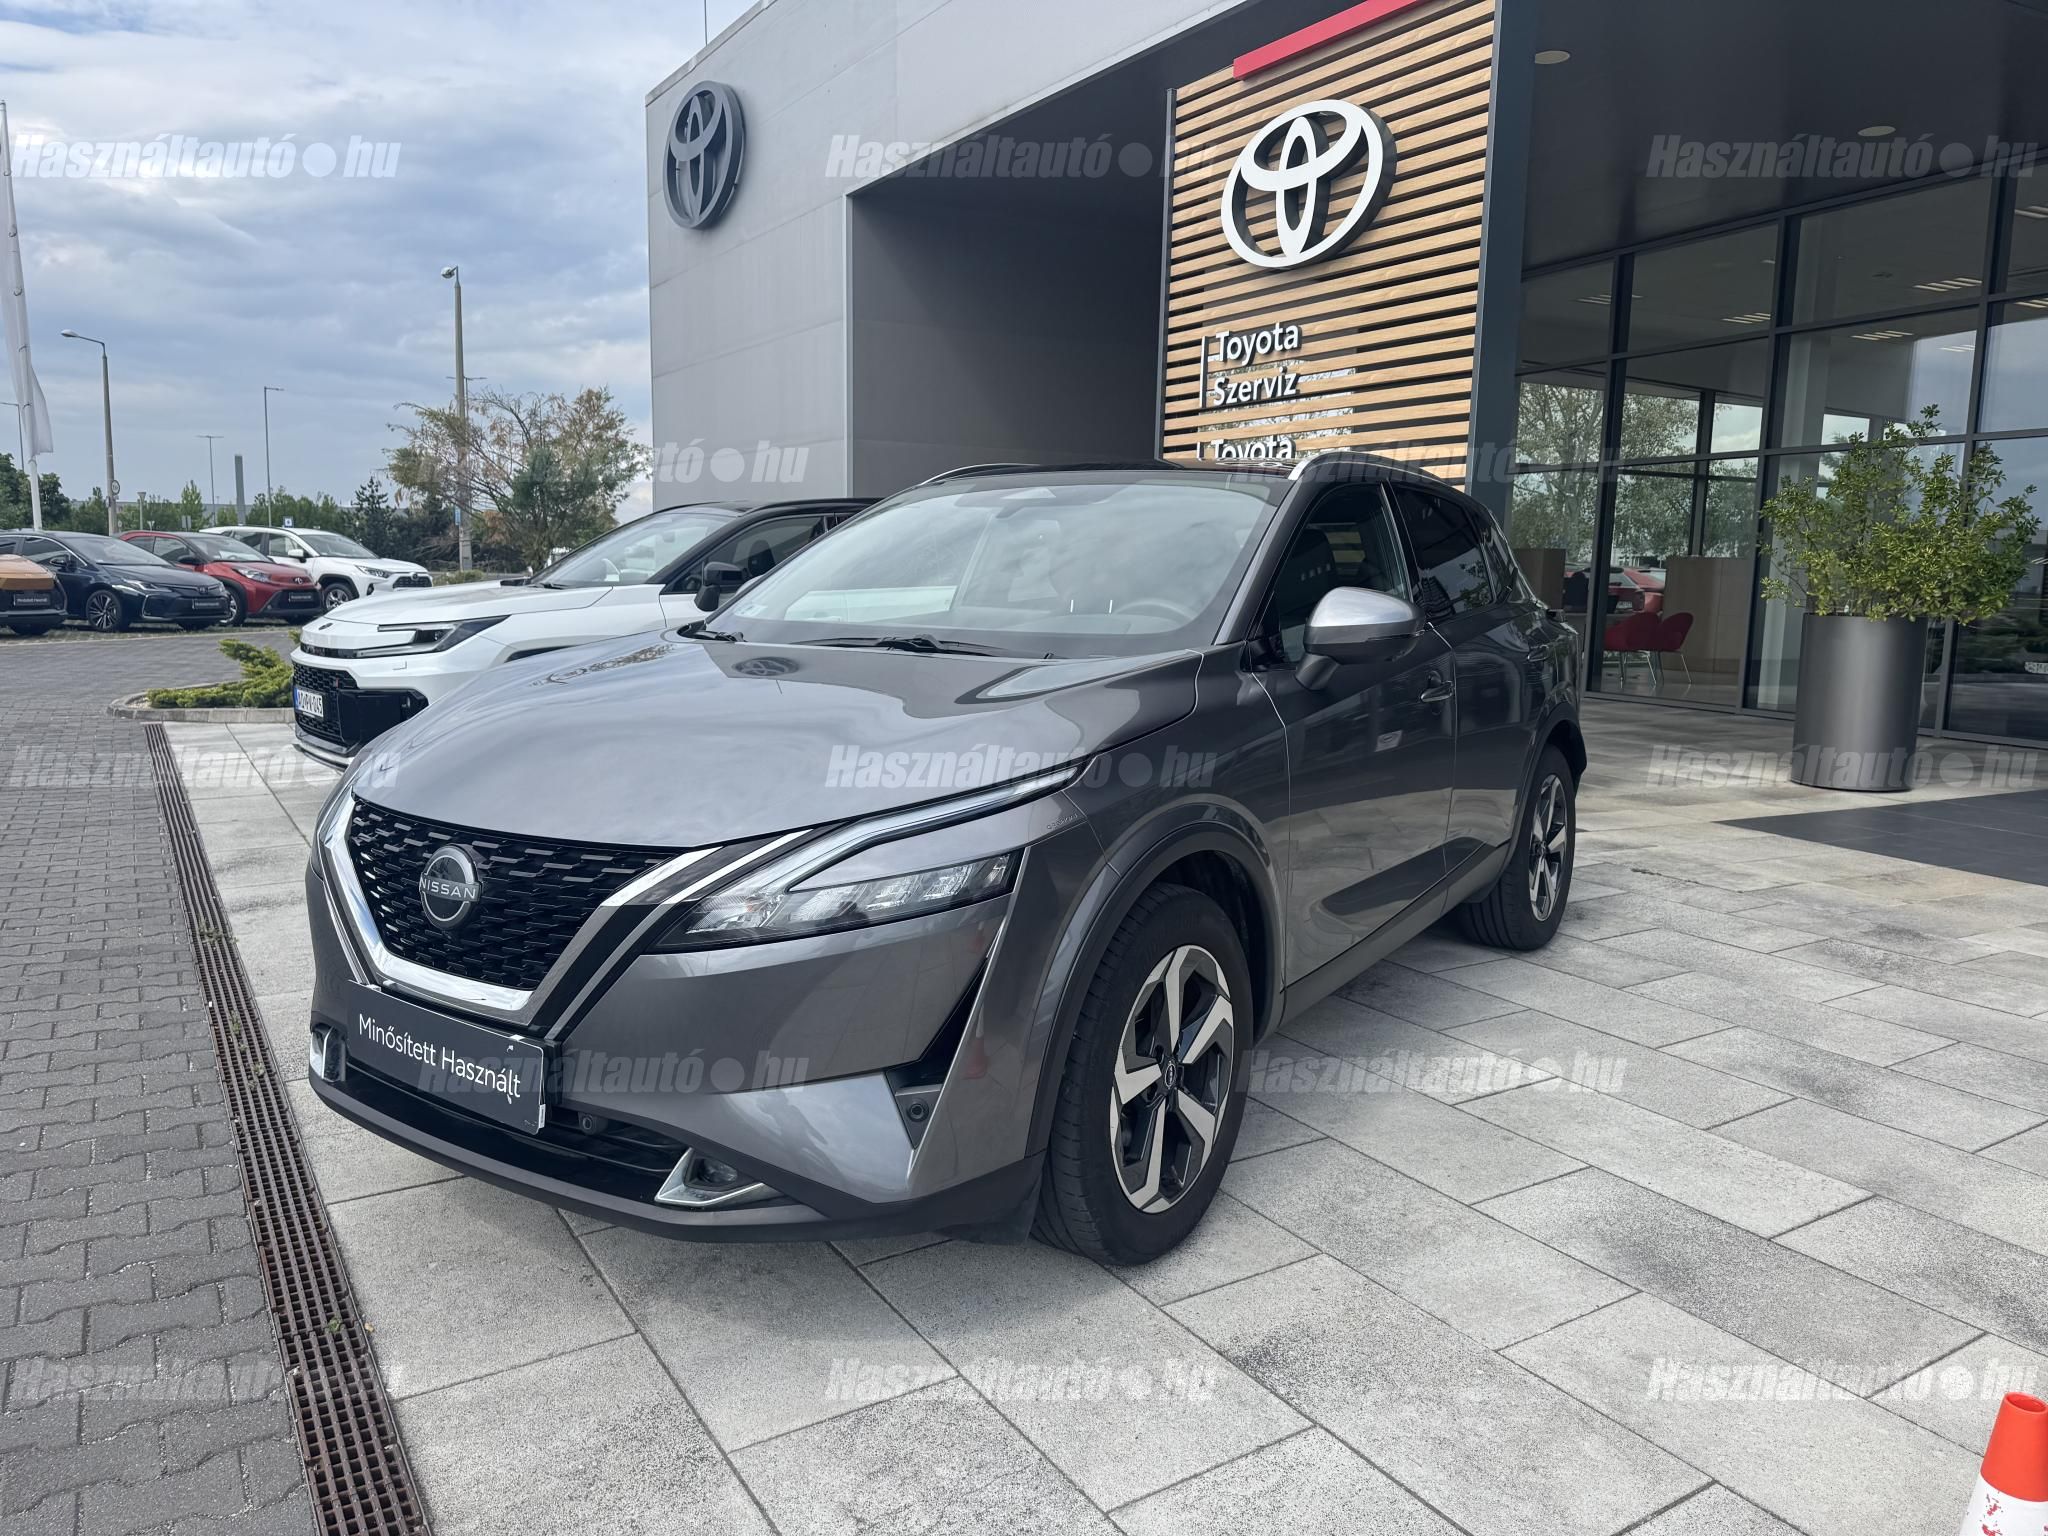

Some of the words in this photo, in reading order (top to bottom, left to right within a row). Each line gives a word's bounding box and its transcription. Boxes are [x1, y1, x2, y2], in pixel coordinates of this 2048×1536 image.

[1216, 322, 1299, 366] Toyota
[1213, 367, 1298, 406] Szerviz
[419, 877, 476, 899] NISSAN
[359, 1013, 436, 1067] Minősített
[441, 1047, 521, 1098] Használt
